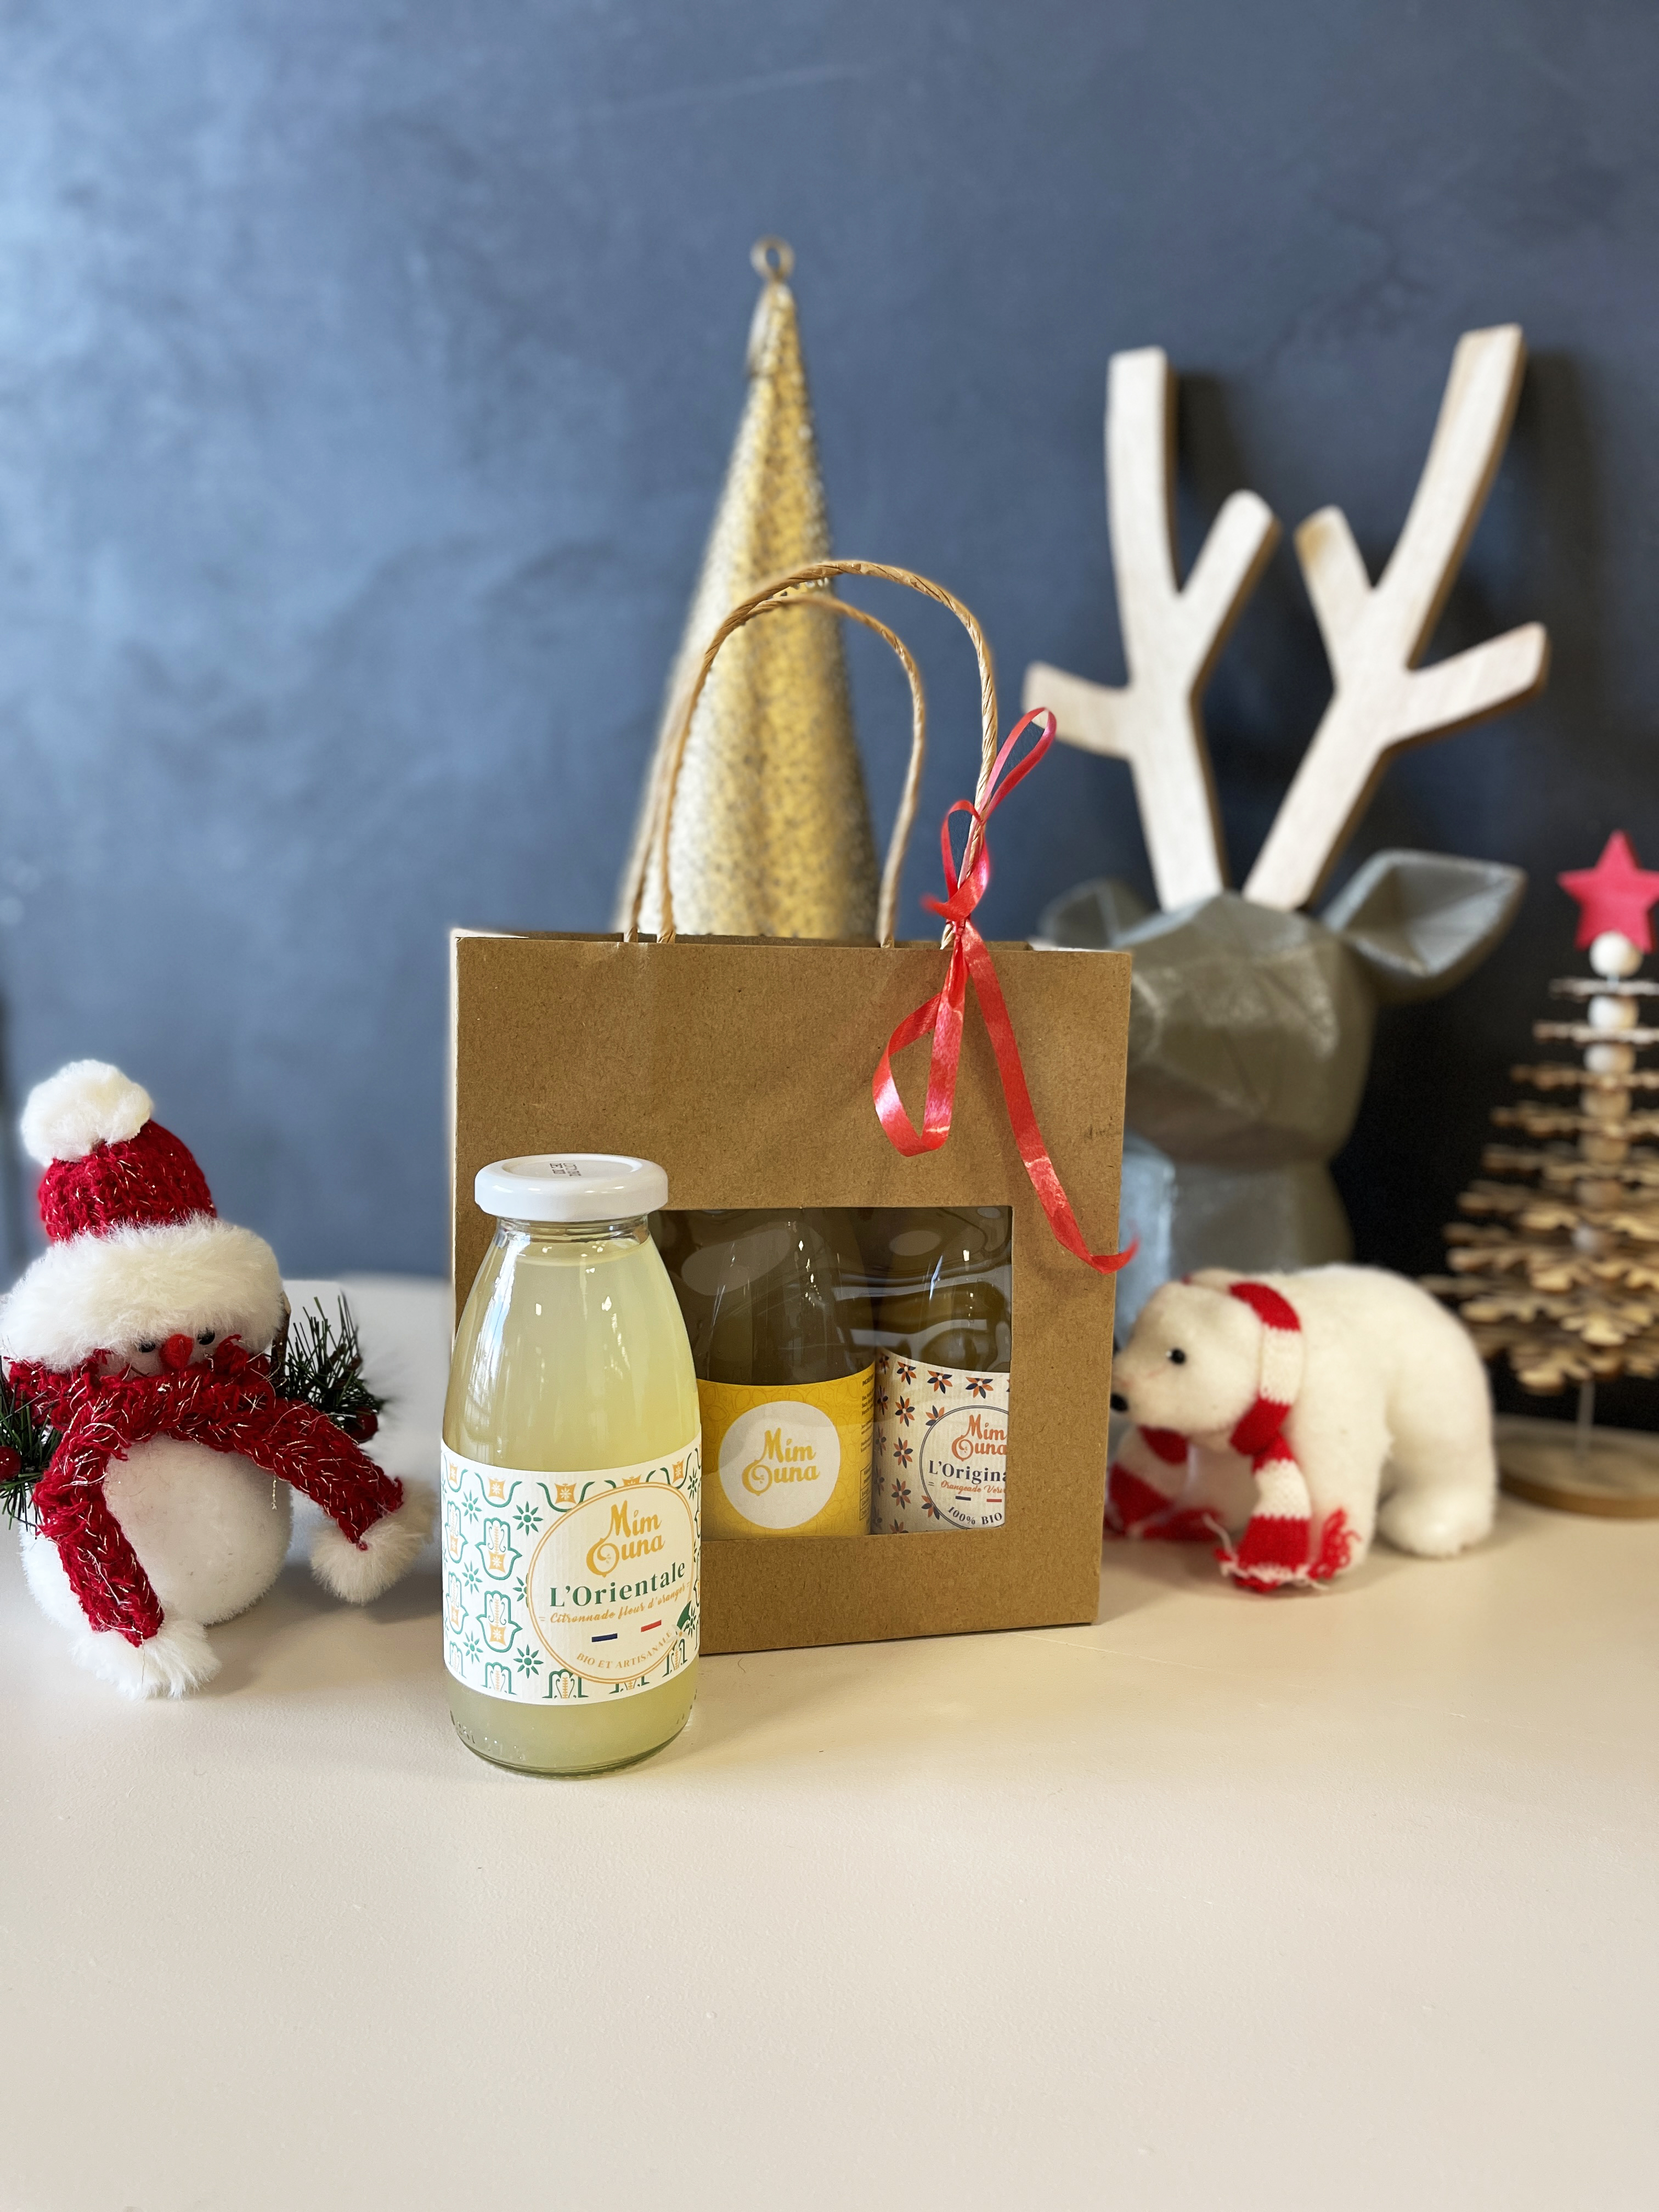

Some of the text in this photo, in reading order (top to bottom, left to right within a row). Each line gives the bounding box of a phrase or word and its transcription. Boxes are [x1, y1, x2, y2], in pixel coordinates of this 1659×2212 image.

[763, 1427, 816, 1463] Mim
[967, 1414, 1007, 1440] Mim
[742, 1459, 821, 1496] Ouna
[940, 1480, 981, 1495] Orangeade
[609, 1500, 662, 1538] Mim
[947, 1506, 1002, 1525] 100% BIO
[586, 1536, 665, 1578] Ouna
[550, 1562, 685, 1607] L'Orientale
[550, 1583, 685, 1623] Citronnade fleur d'oranger
[576, 1653, 595, 1666] BIO
[615, 1630, 672, 1669] ARTISANALE
